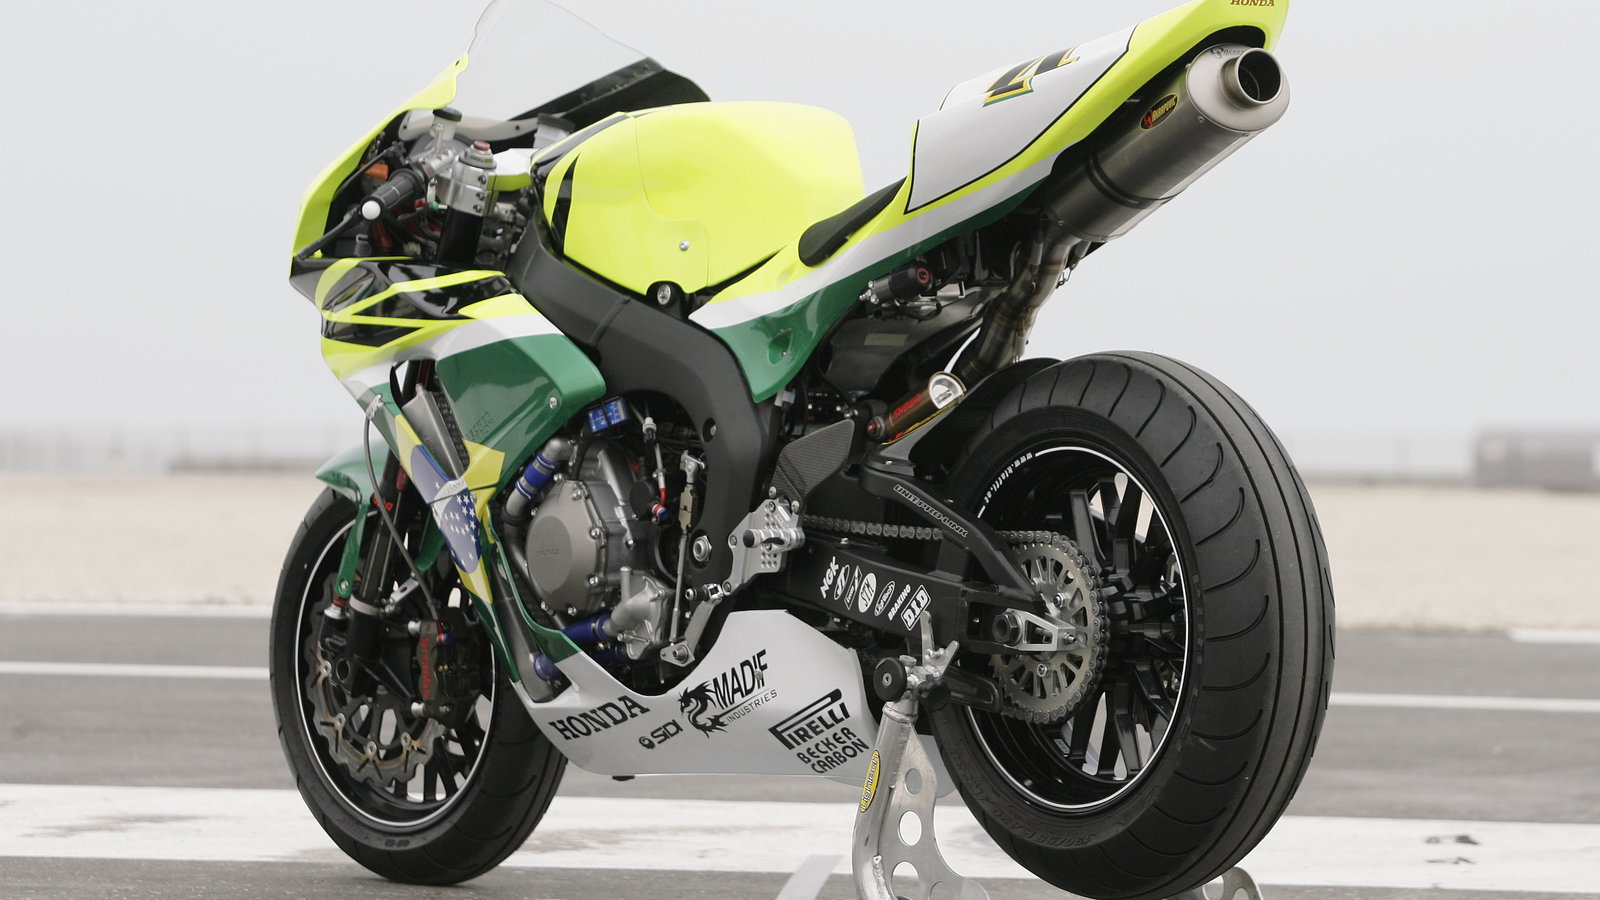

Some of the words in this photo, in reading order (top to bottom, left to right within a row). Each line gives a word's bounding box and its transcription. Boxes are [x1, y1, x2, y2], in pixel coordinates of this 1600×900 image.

[893, 484, 920, 505] UNIT
[820, 556, 839, 599] NGK
[888, 584, 911, 621] BRAKING
[548, 695, 651, 740] HONDA
[726, 689, 778, 725] INDUSTRIES
[768, 688, 851, 751] PIRELLI
[796, 727, 857, 764] BECKER
[811, 738, 869, 774] CARBON
